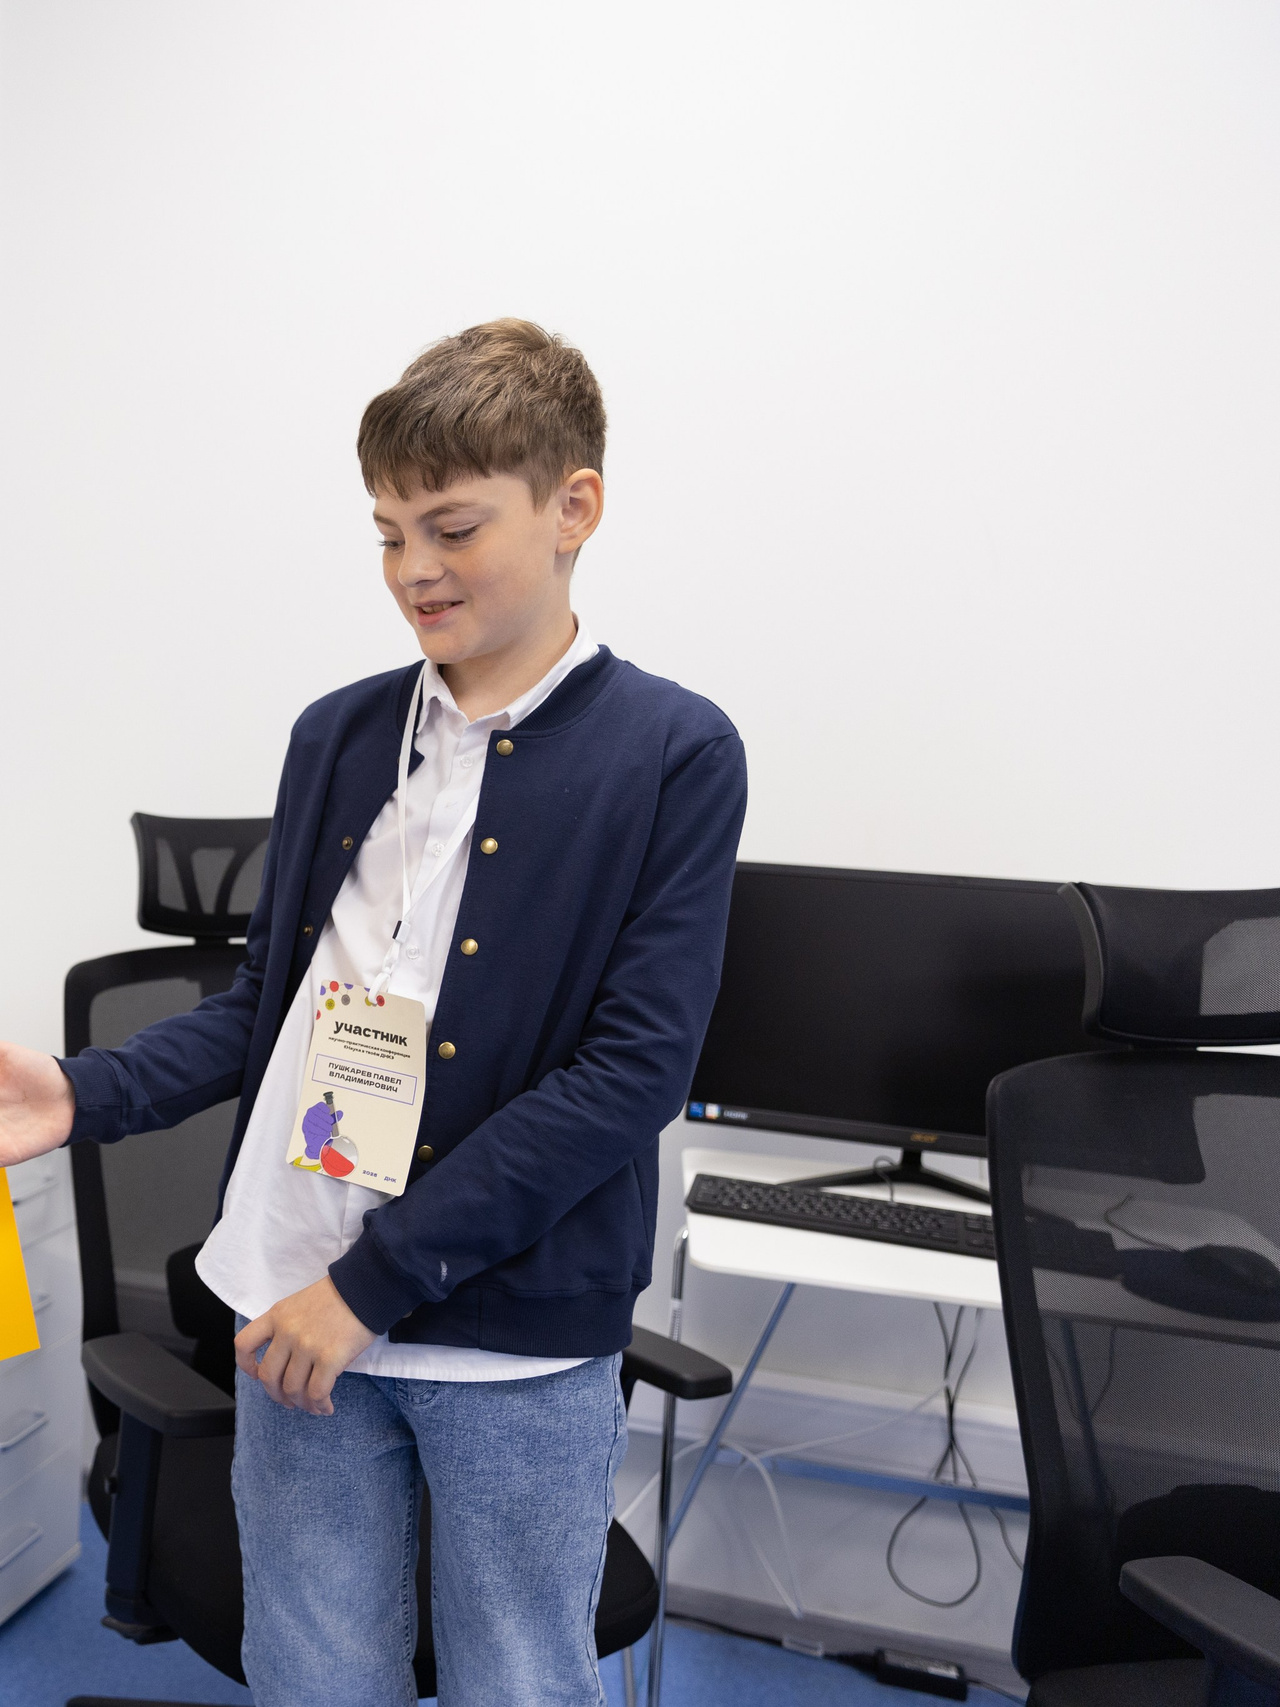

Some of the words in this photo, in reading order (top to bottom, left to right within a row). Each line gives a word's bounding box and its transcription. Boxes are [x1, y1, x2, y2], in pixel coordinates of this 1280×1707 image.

[333, 1021, 408, 1047] участник
[328, 1062, 372, 1078] ПУШКАРЕВ
[373, 1073, 402, 1086] ПАВЕЛ
[329, 1071, 398, 1093] ВЛАДИМИРОВИЧ
